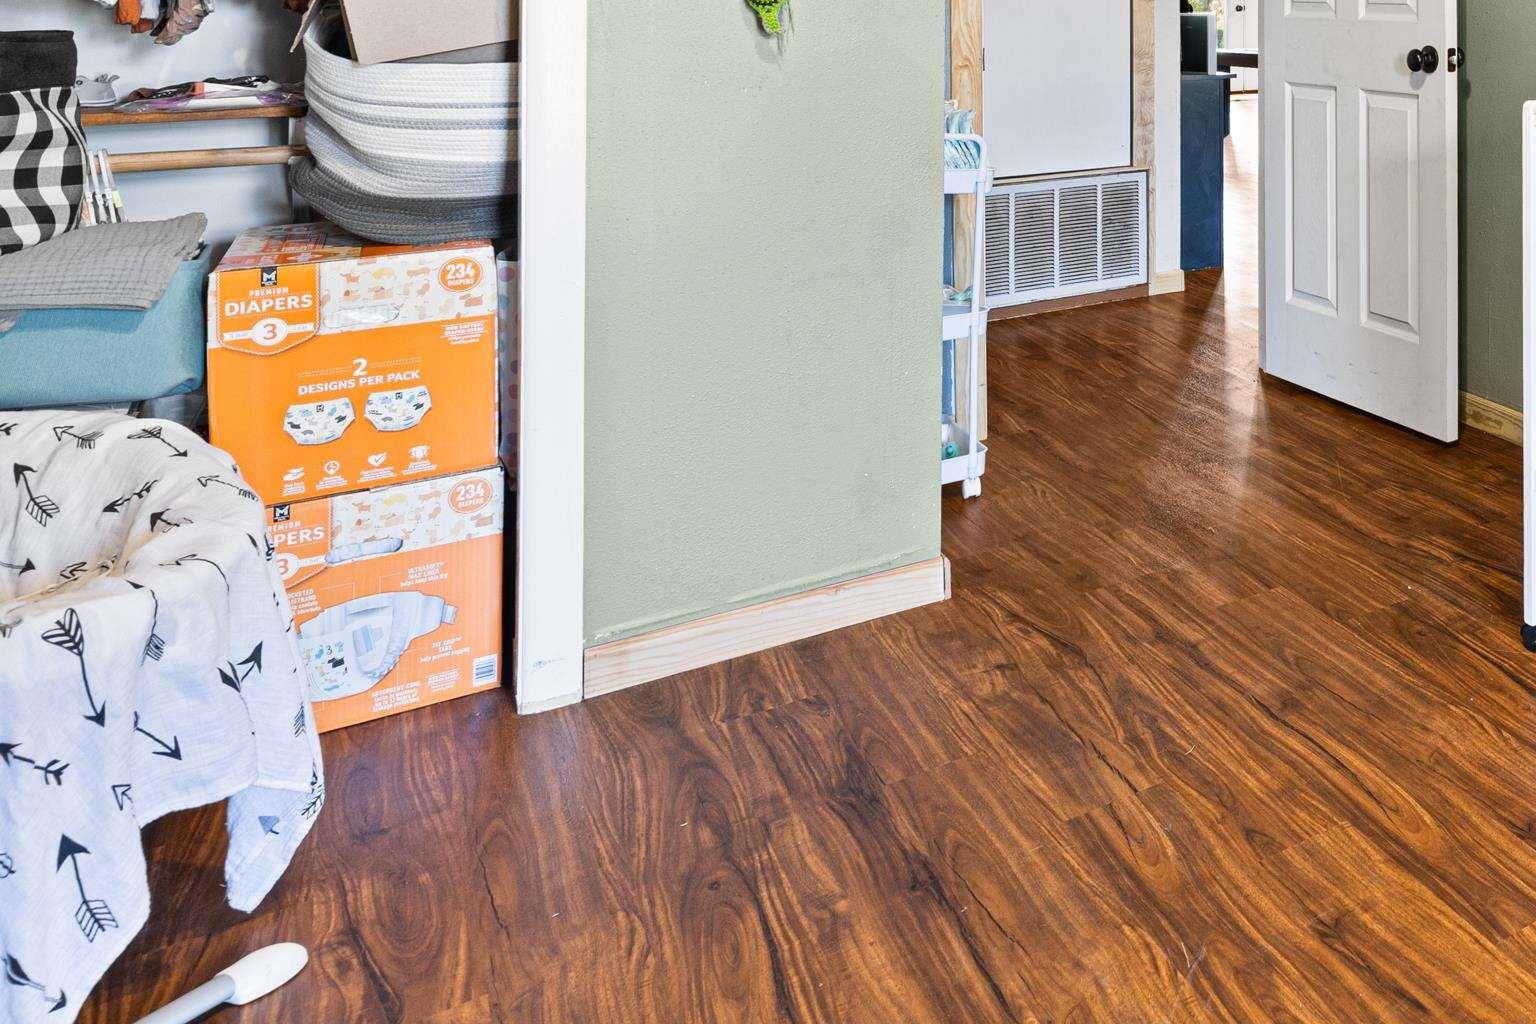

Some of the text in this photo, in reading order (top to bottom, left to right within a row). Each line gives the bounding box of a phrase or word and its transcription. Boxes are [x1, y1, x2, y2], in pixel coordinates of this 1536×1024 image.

[446, 262, 475, 280] 234
[248, 287, 289, 297] PREMIUM
[224, 294, 313, 317] DIAPERS
[263, 323, 278, 340] 3
[352, 357, 368, 377] 2
[298, 369, 420, 396] DESIGNS PER PACK
[456, 482, 486, 501] 234
